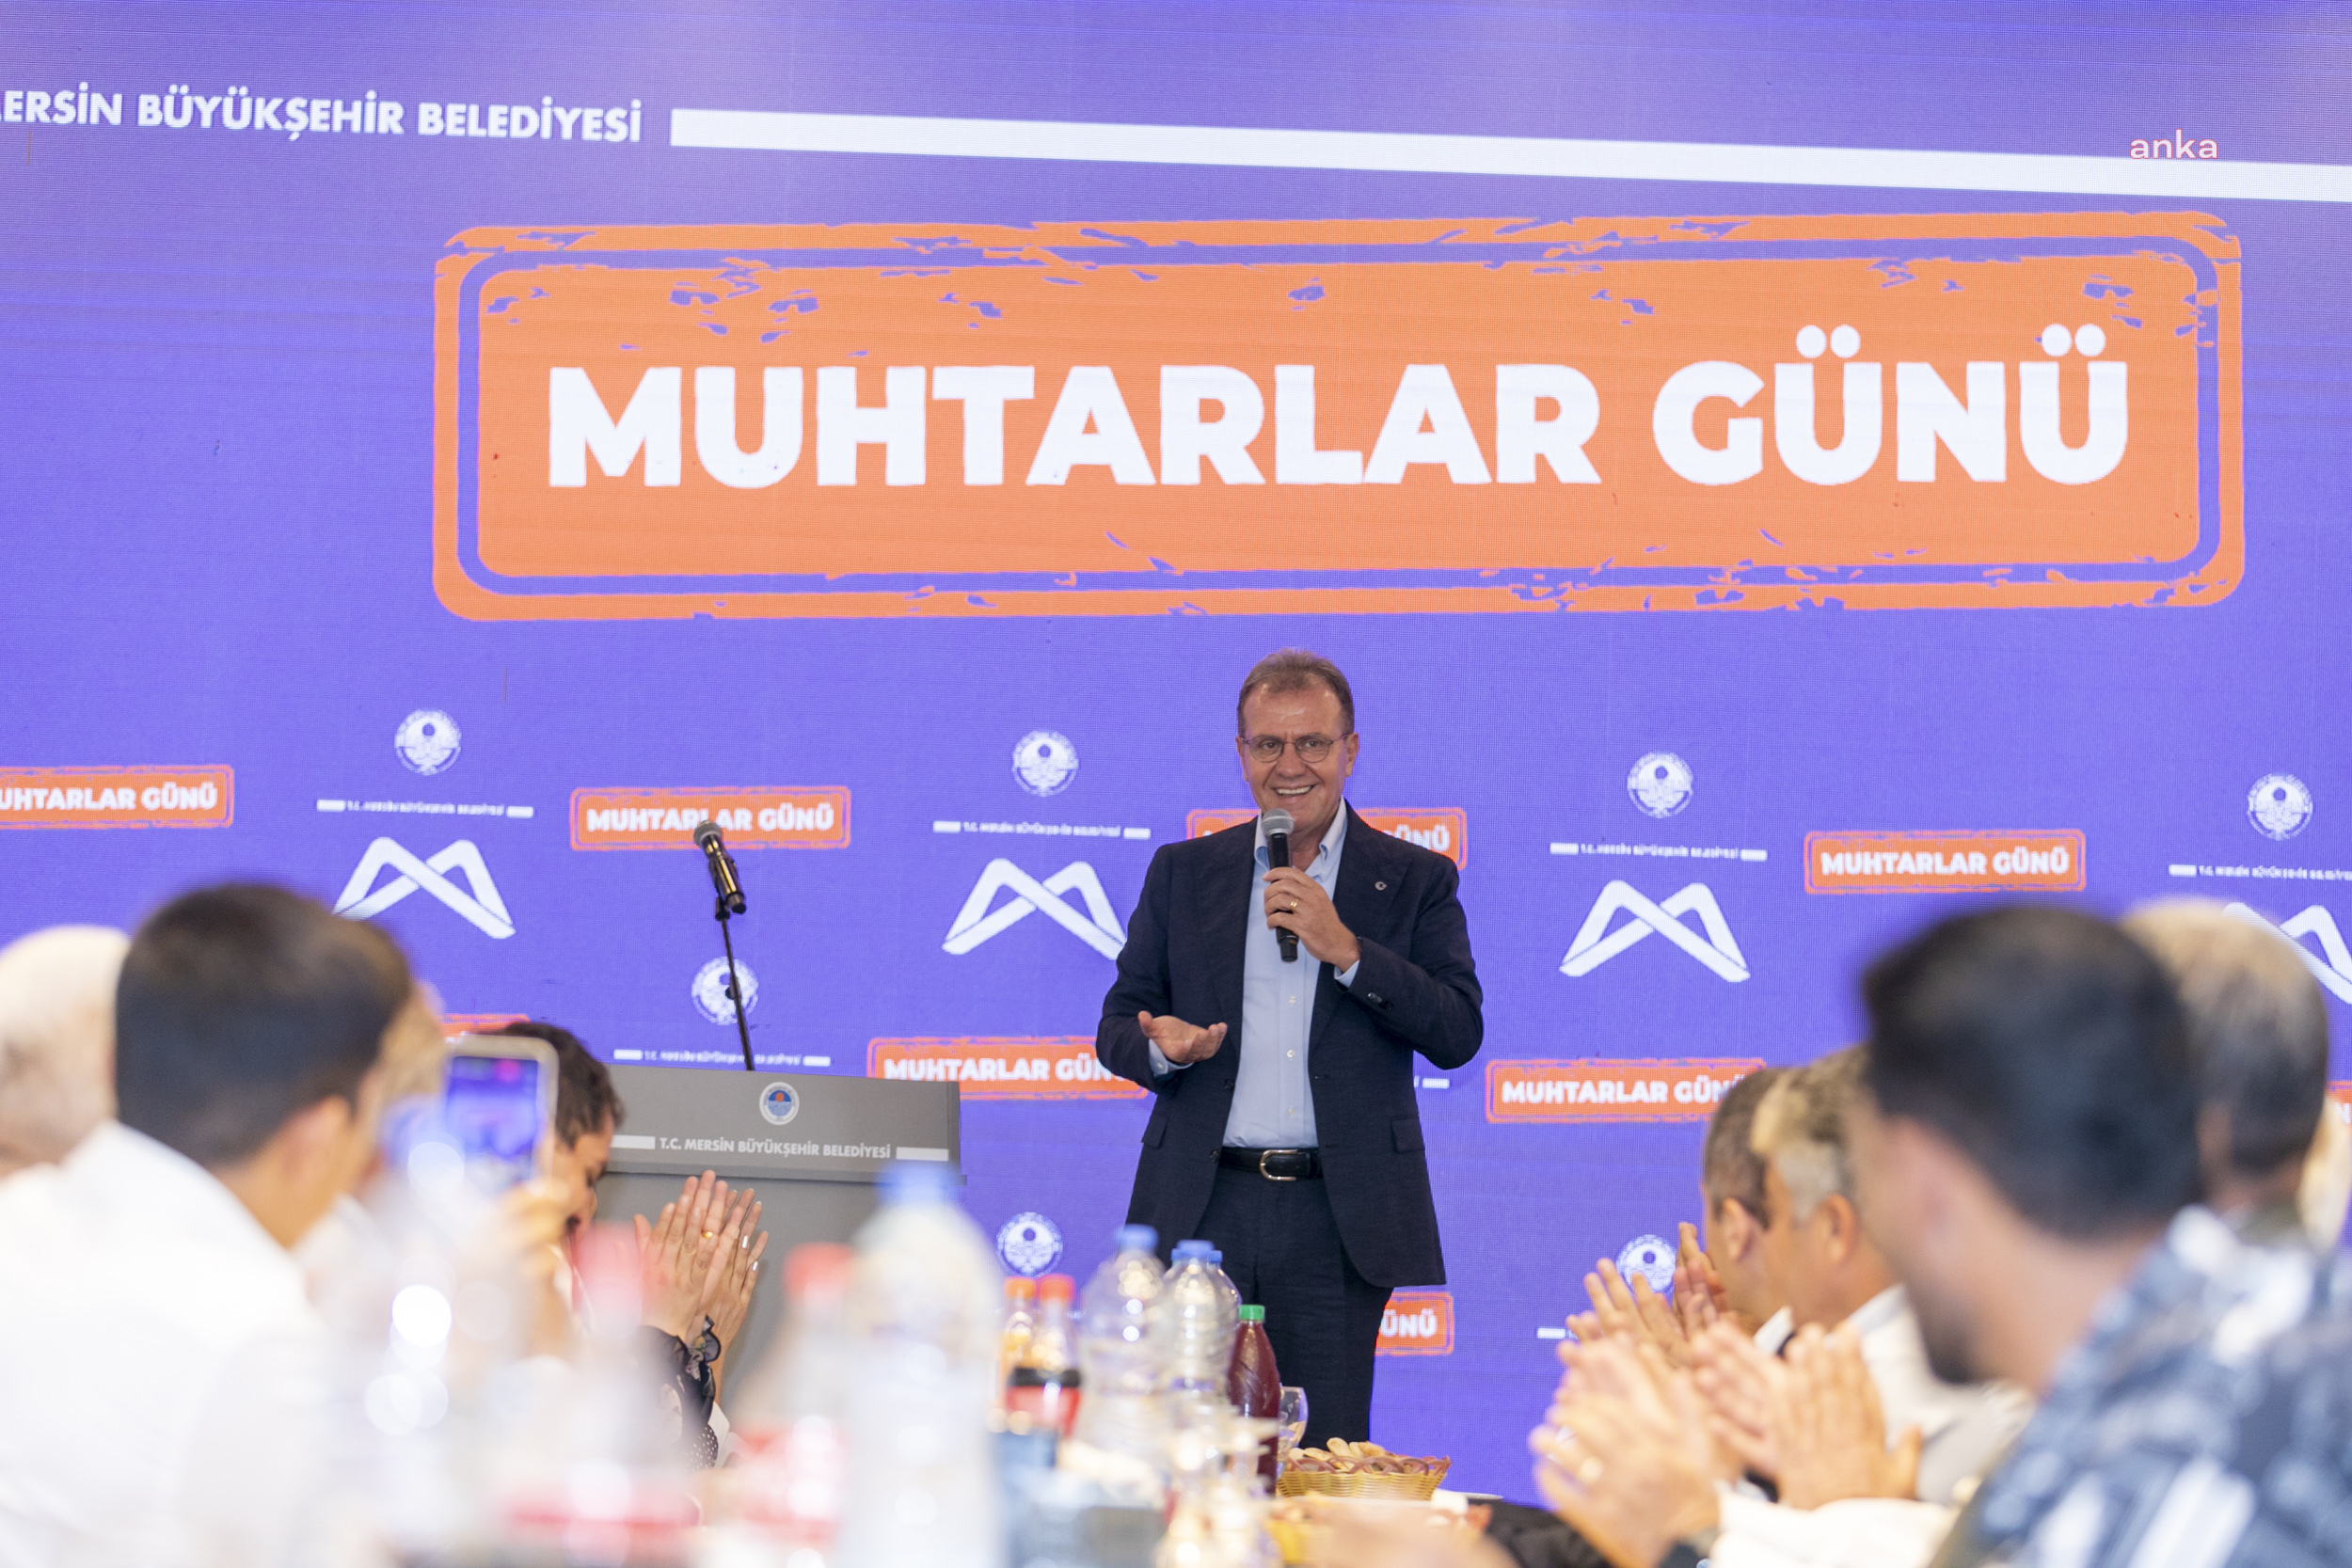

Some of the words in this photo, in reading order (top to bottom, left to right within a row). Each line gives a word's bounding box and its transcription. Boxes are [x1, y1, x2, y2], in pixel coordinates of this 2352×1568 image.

[0, 81, 123, 126] ERSİN
[137, 84, 405, 141] BÜYÜKŞEHİR
[418, 96, 642, 143] BELEDİYESİ
[549, 364, 1602, 489] MUHTARLAR
[1652, 324, 2128, 486] GÜNÜ
[140, 782, 218, 811] GÜNÜ
[757, 802, 834, 832] GÜNÜ
[1383, 824, 1450, 852] ÜNÜ
[1820, 850, 1987, 875] MUHTARLAR
[1993, 846, 2070, 875] GÜNÜ
[883, 1058, 1050, 1081] MUHTARLAR
[1055, 1053, 1124, 1082] GÜN
[1502, 1080, 1668, 1103] MUHTARLAR
[660, 1137, 681, 1150] T.C.
[684, 1136, 734, 1153] MERSİN
[738, 1138, 819, 1158] BÜYÜKŞEHİR
[823, 1143, 891, 1159] BELEDİYESİ
[1380, 1308, 1437, 1338] ÜNÜ
